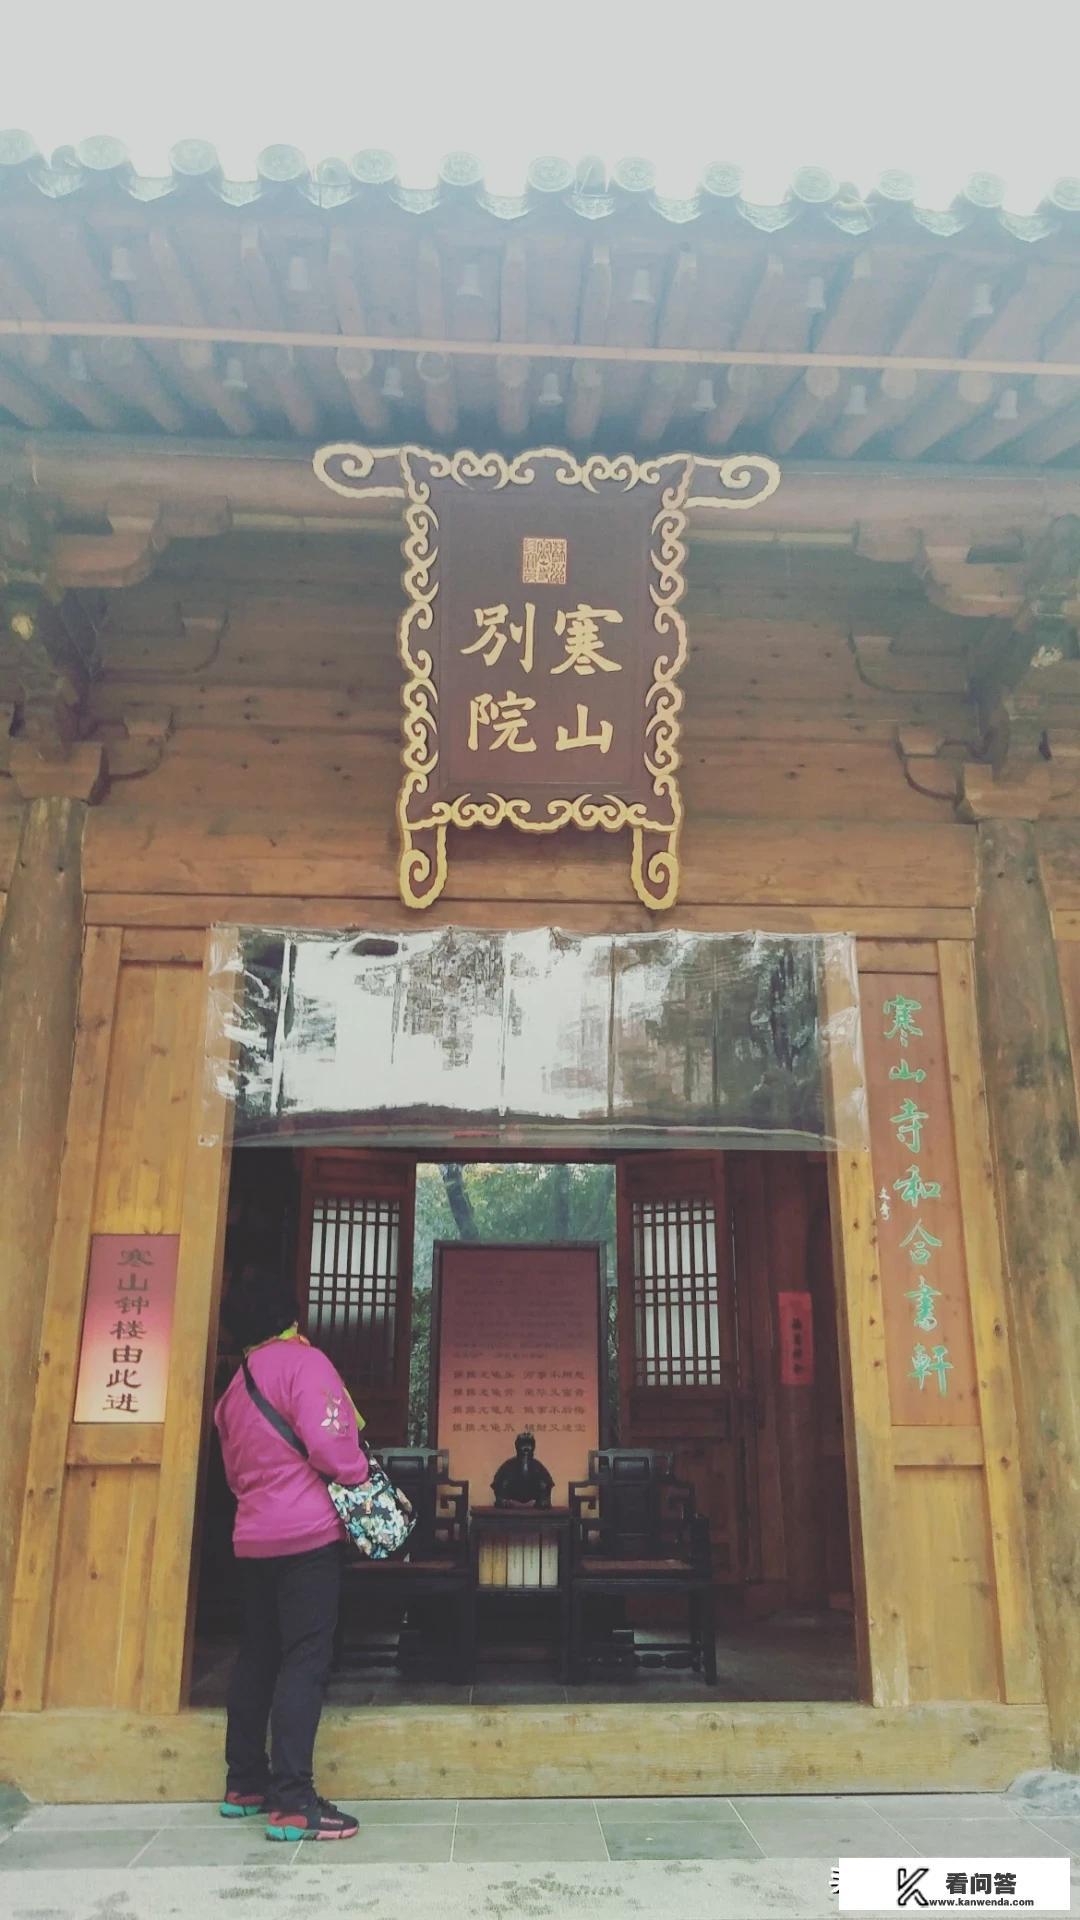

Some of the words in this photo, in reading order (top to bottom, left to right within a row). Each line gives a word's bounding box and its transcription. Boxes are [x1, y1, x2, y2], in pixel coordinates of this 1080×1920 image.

[550, 604, 624, 754] 寒山
[102, 1247, 154, 1413] 寒山钟楼由此进
